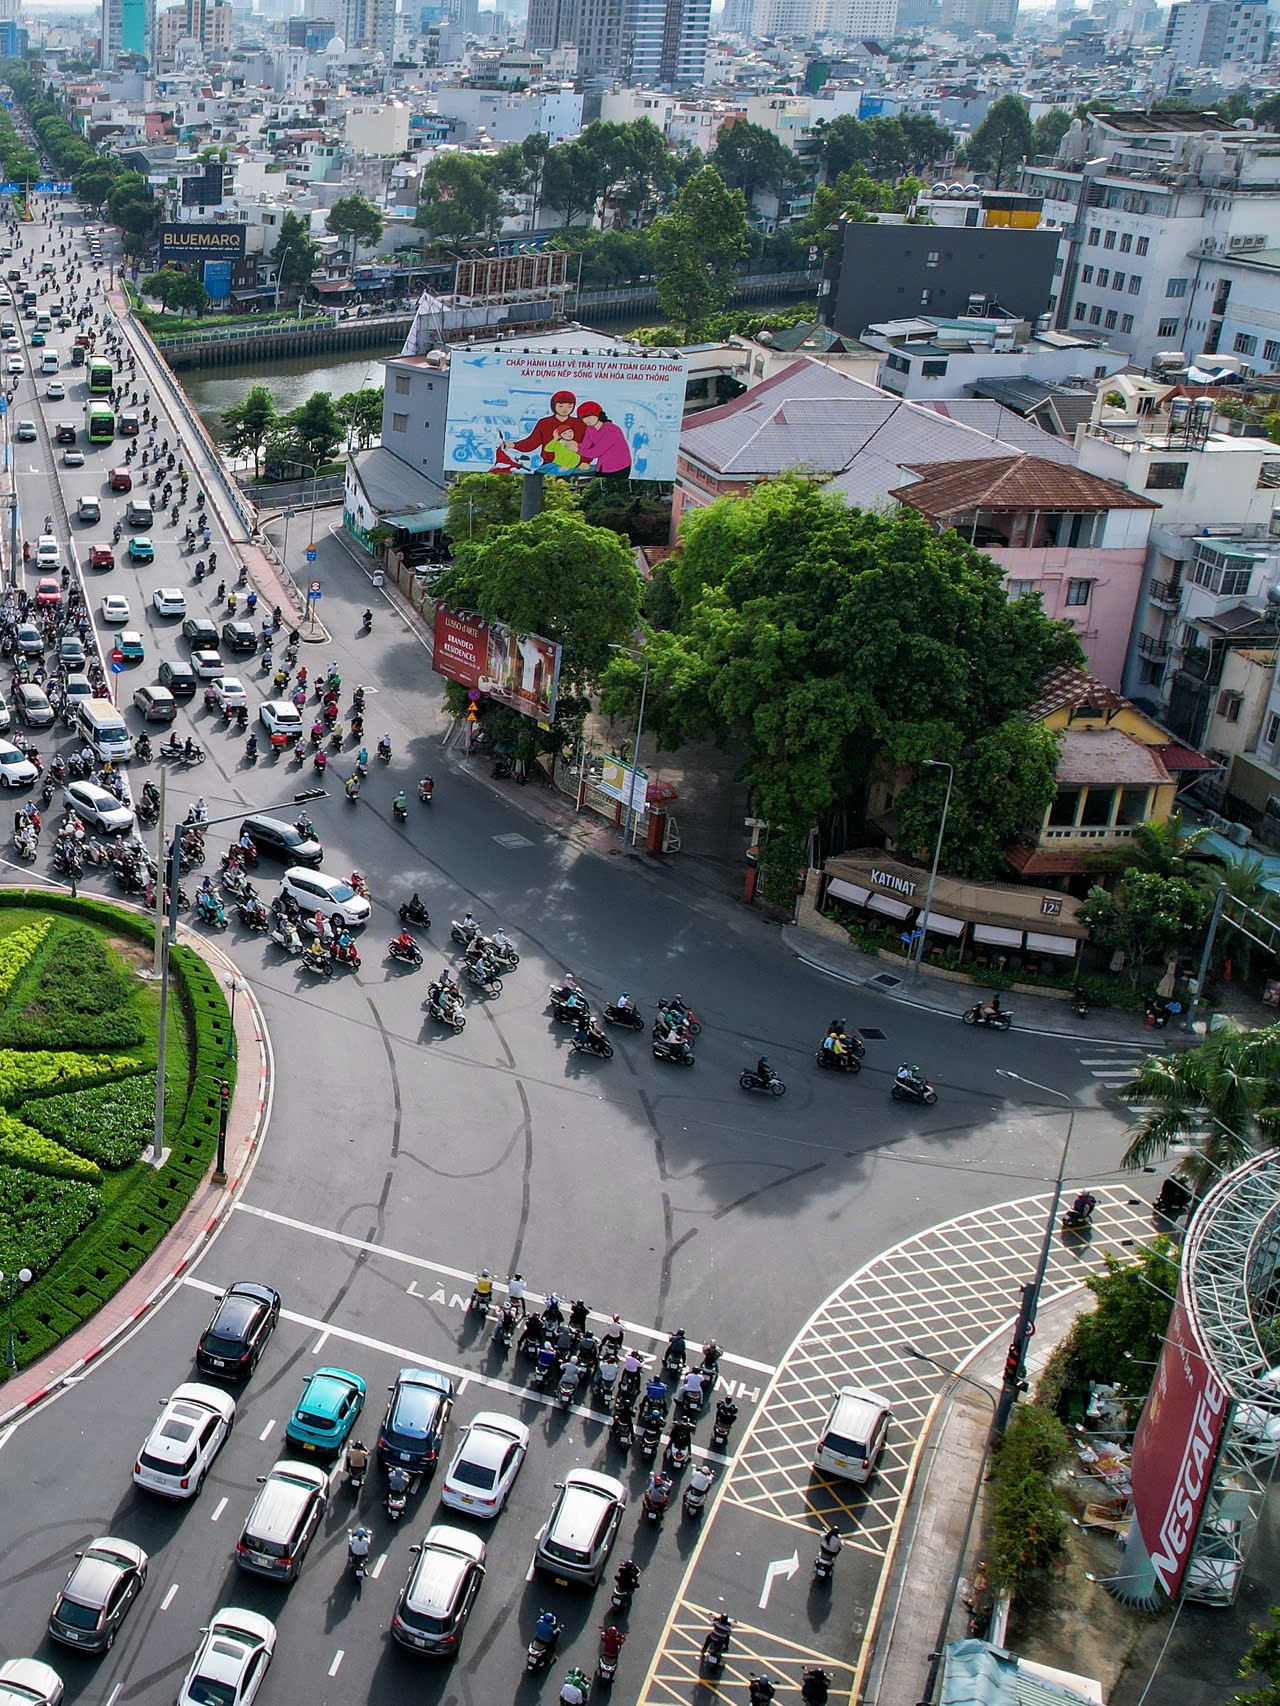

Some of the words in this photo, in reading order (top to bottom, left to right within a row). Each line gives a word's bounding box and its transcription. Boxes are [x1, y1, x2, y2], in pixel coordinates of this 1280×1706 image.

[163, 233, 240, 246] BLUEMARQ
[506, 358, 525, 366] CHẤP
[527, 359, 547, 367] HÀNH
[548, 360, 566, 369] LUẬT
[567, 359, 577, 368] VỀ
[578, 360, 595, 369] TRẬT
[597, 362, 607, 371] TỰ
[620, 362, 638, 371] TOÀN
[640, 363, 657, 371] GIAO
[658, 363, 683, 372] THÔNG
[521, 368, 535, 377] XÂY
[536, 370, 556, 378] DỰNG
[557, 368, 572, 377] NẾP
[573, 369, 593, 379] SỐNG
[594, 370, 609, 379] VĂN
[610, 372, 625, 380] HÓA
[626, 373, 644, 381] GIAO
[645, 373, 670, 382] THÔNG
[447, 634, 474, 651] BRANDED
[444, 642, 476, 663] RESIDENCES
[871, 868, 917, 897] KATINAT
[406, 1280, 472, 1312] LÀN
